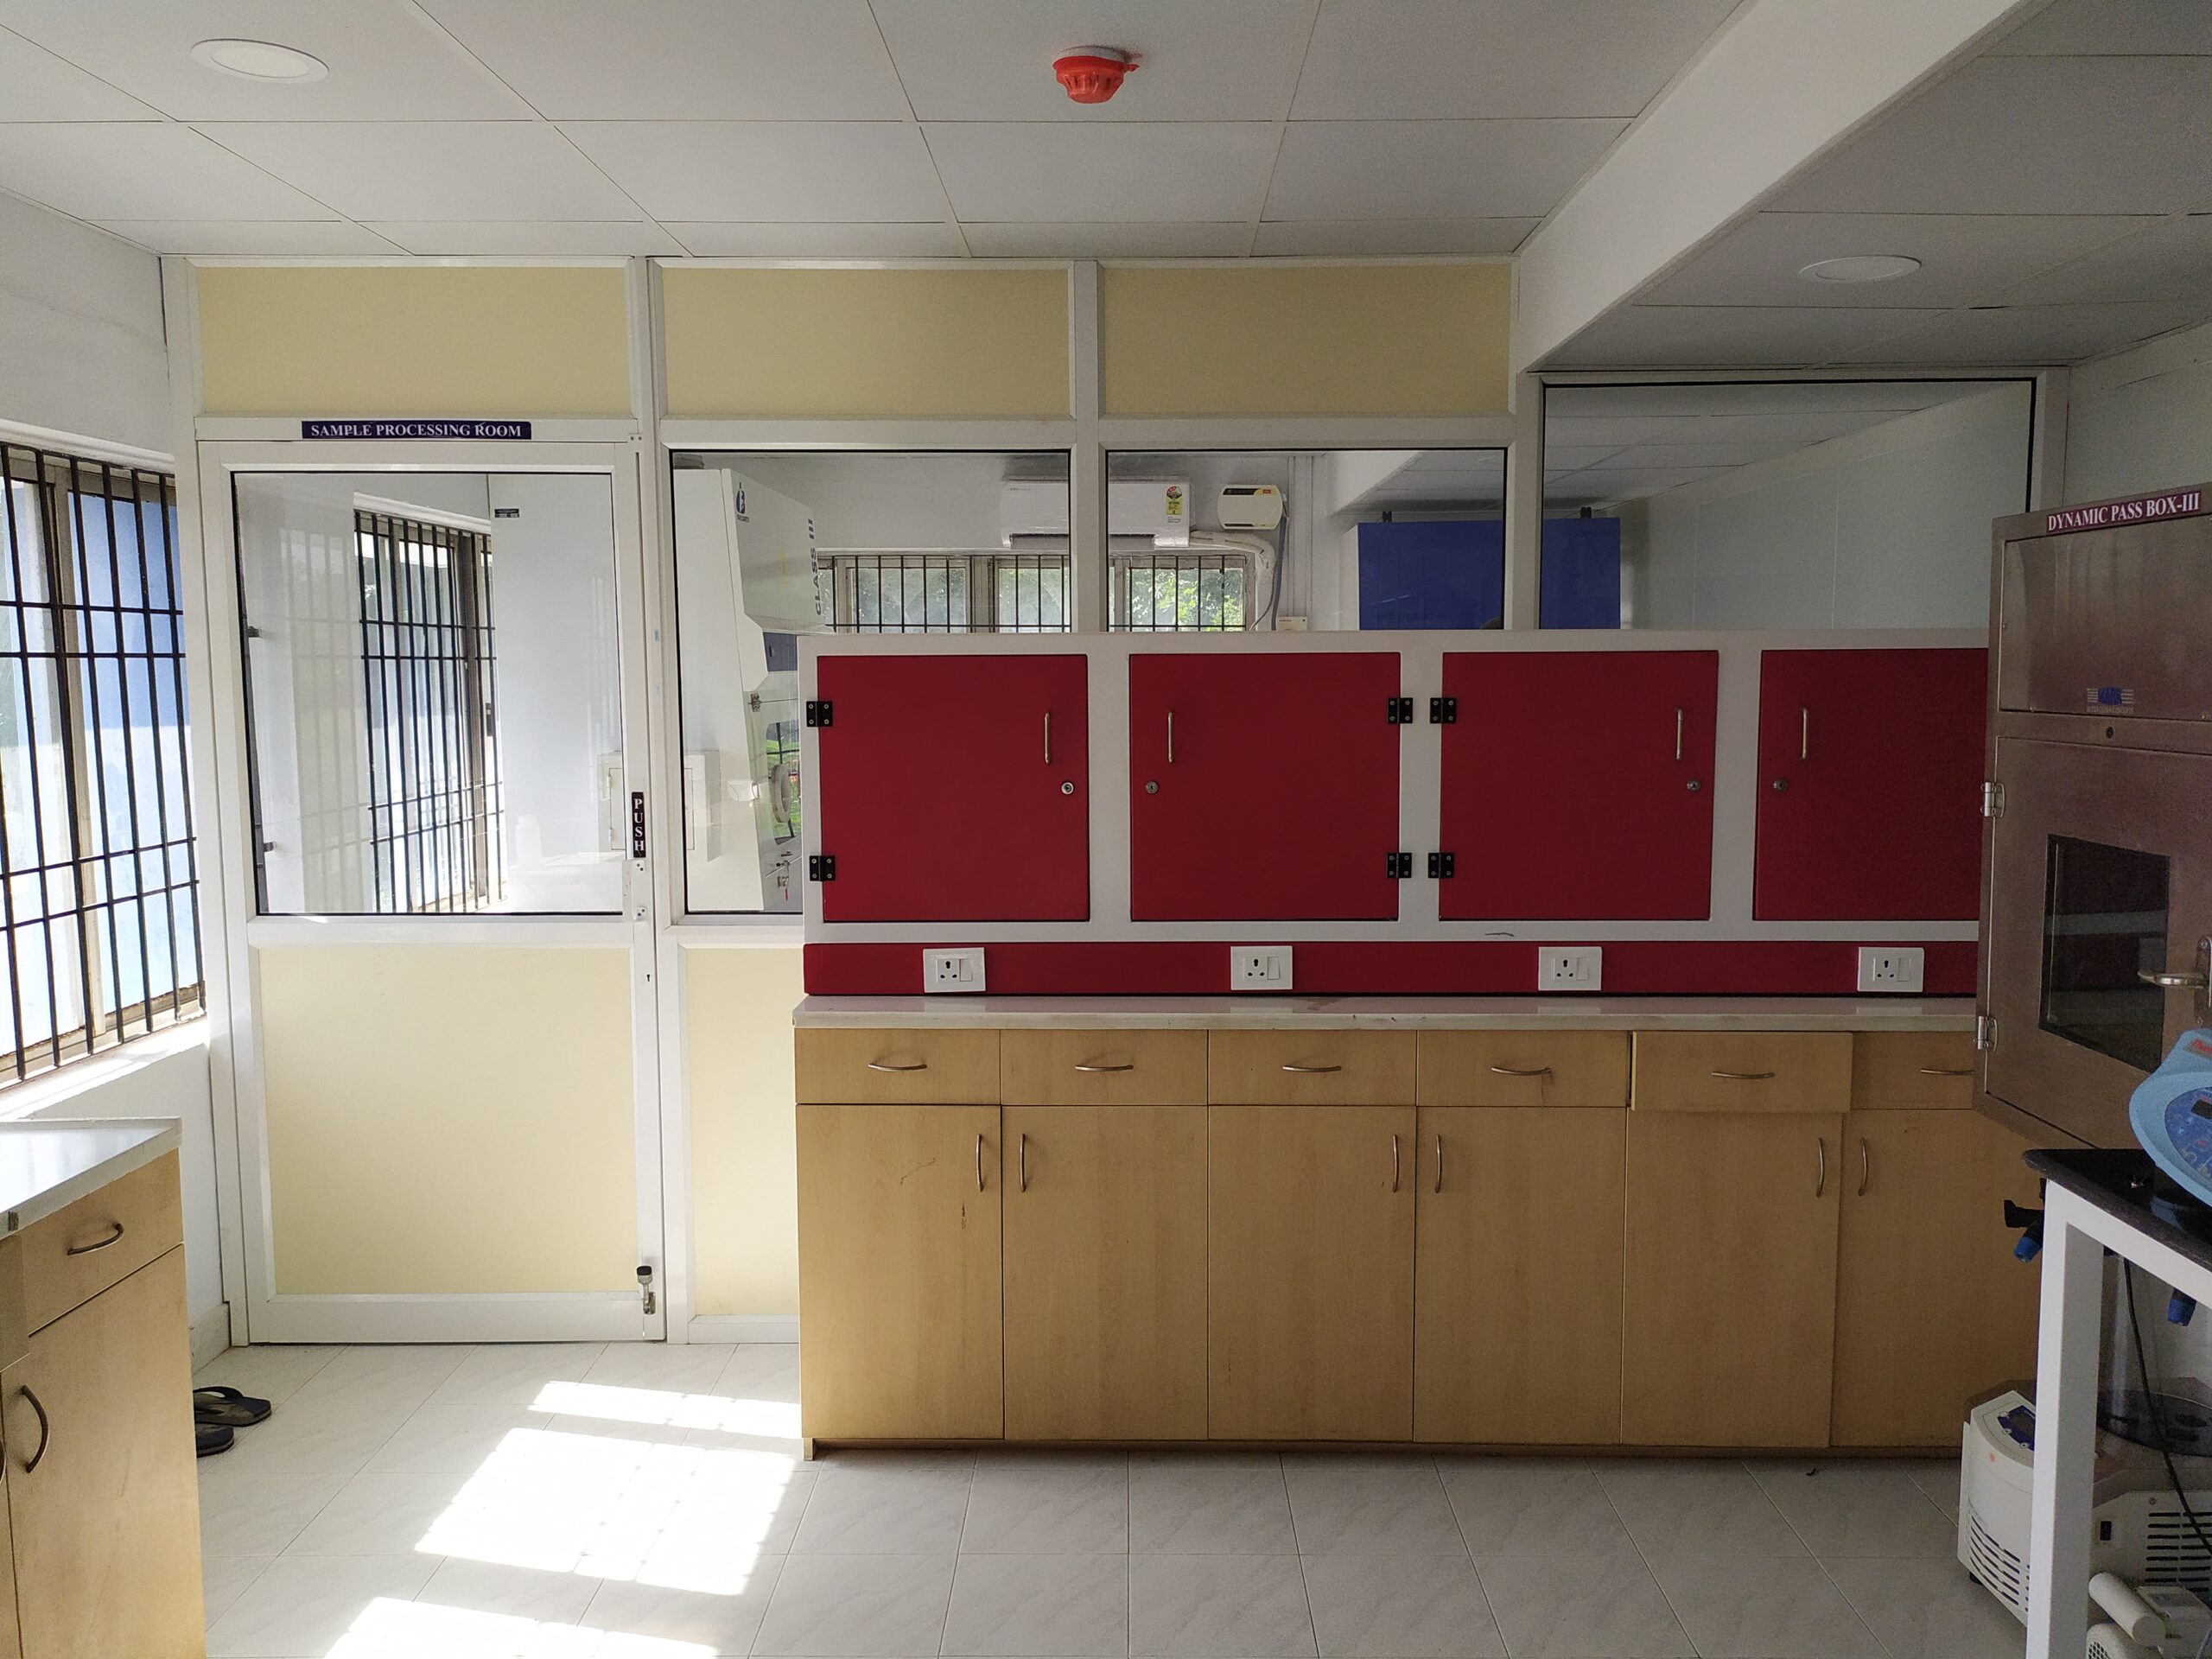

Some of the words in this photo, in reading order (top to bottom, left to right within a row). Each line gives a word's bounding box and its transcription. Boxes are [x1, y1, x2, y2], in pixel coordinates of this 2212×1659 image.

[312, 425, 372, 436] SAMPLE
[376, 424, 471, 436] PROCESSING
[475, 424, 522, 437] ROOM
[2048, 506, 2108, 531] DYNAMIC
[2111, 501, 2143, 522] PASS
[2146, 492, 2201, 517] BOX-III
[810, 548, 822, 615] CLASS
[633, 798, 645, 851] PUSH
